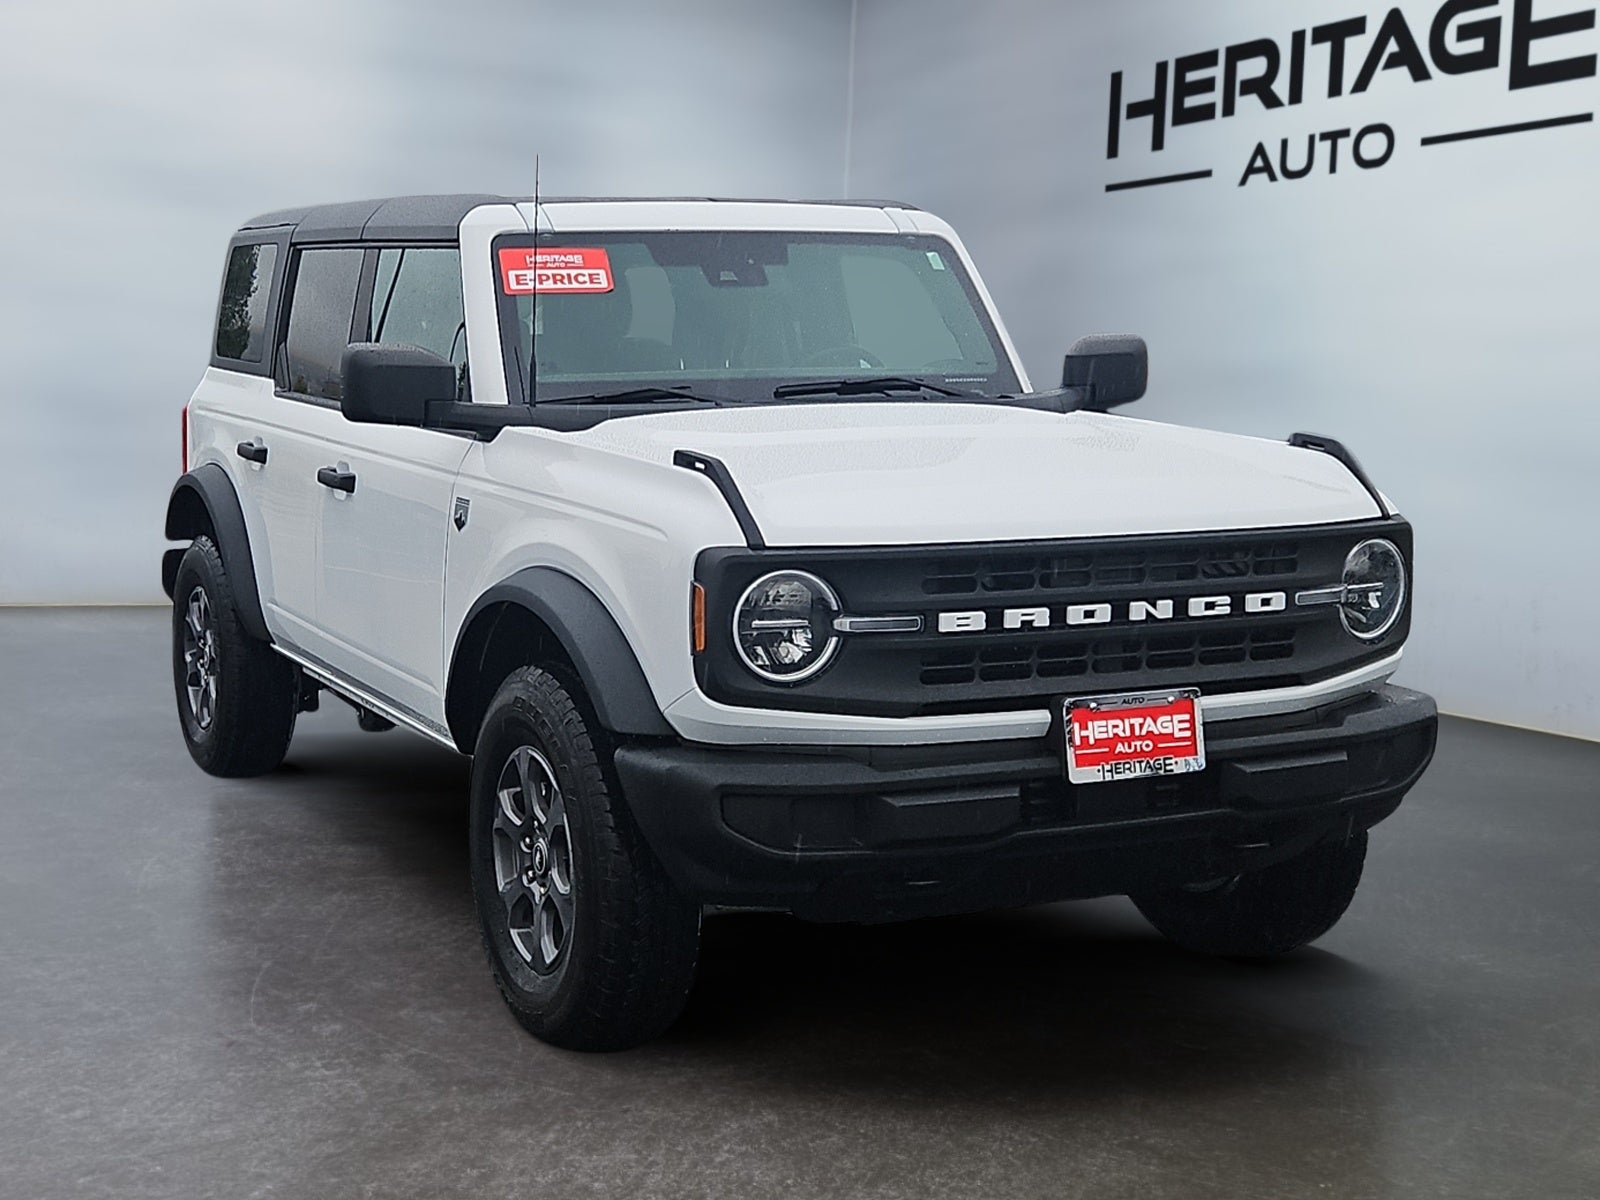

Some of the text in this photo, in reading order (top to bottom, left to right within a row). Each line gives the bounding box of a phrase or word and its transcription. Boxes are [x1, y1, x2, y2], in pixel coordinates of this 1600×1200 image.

[1106, 0, 1598, 159] HERITAGE
[1238, 123, 1395, 187] AUTO
[525, 254, 583, 265] HERITAGE
[514, 272, 602, 286] E-PRICE
[938, 592, 1286, 633] BRONCO
[1121, 697, 1145, 705] AUTO
[1074, 714, 1192, 746] HERITAGE
[1115, 740, 1154, 755] AUTO
[1101, 757, 1175, 780] HERITAGE
